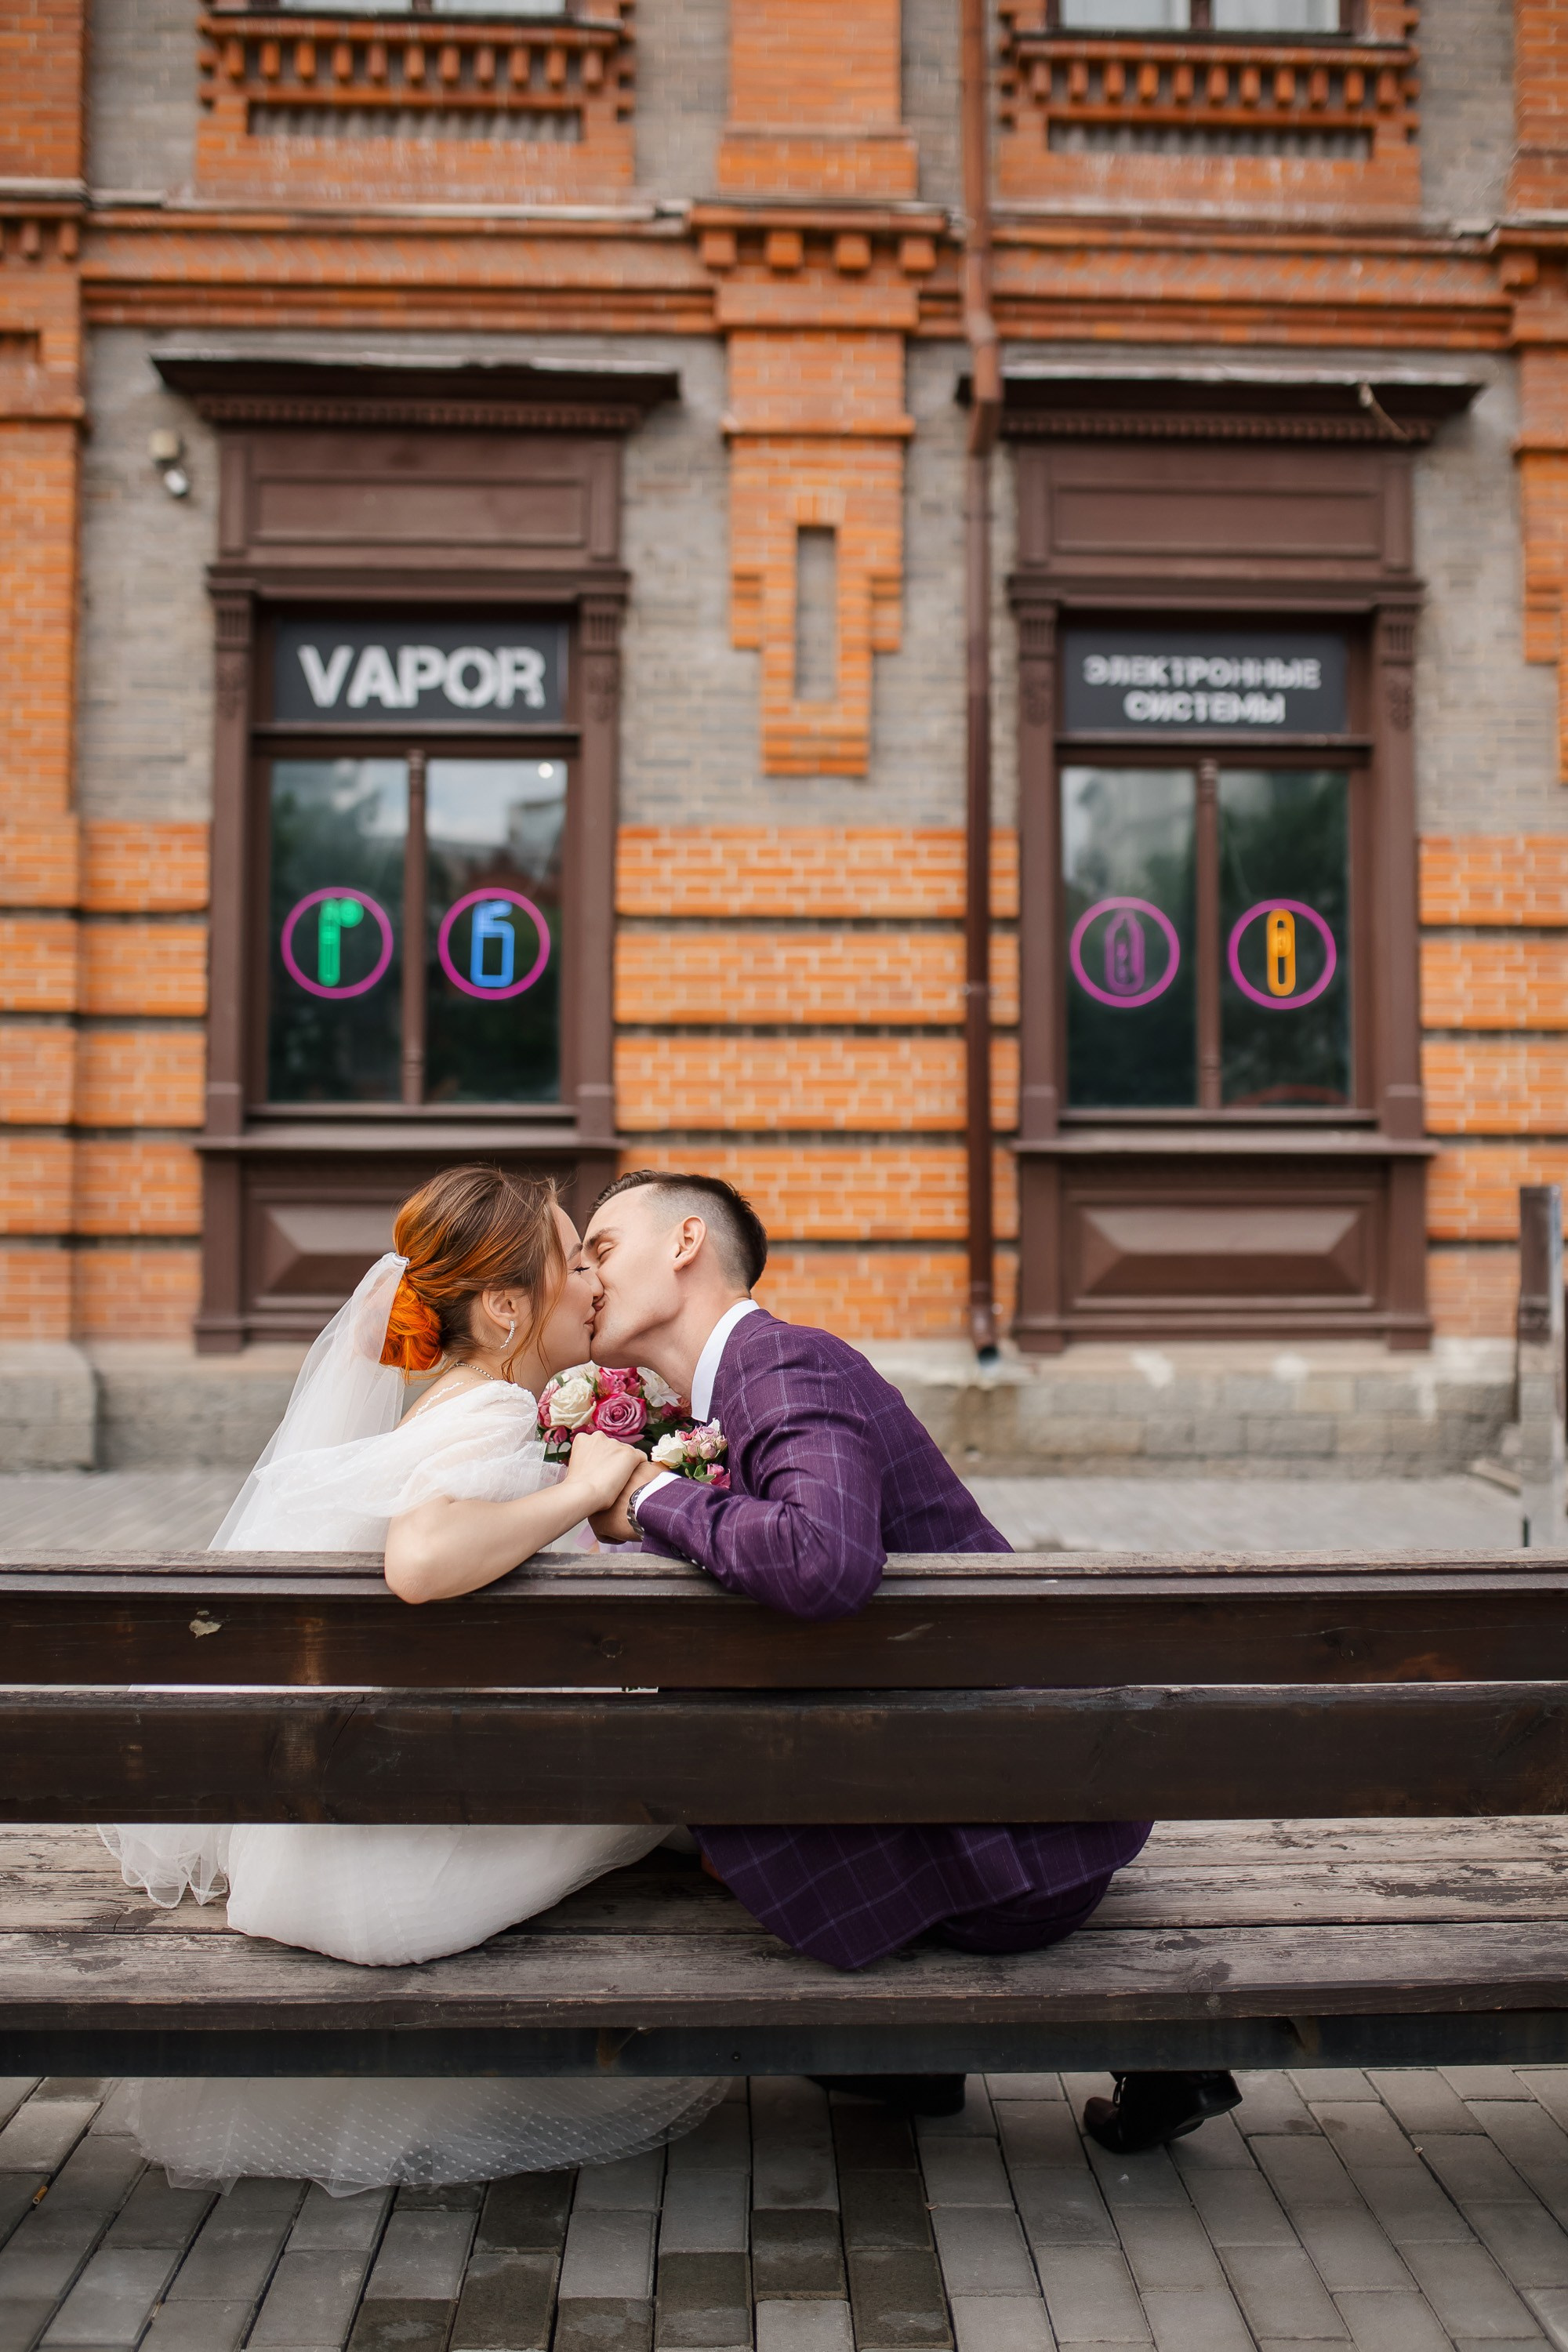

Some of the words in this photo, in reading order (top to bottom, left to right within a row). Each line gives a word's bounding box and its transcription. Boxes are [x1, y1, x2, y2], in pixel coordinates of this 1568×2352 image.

[297, 644, 546, 710] VAPOR
[1083, 655, 1321, 690] ЭЛЕКТРОННЫЕ
[1123, 690, 1286, 724] СИСТЕМЫ
